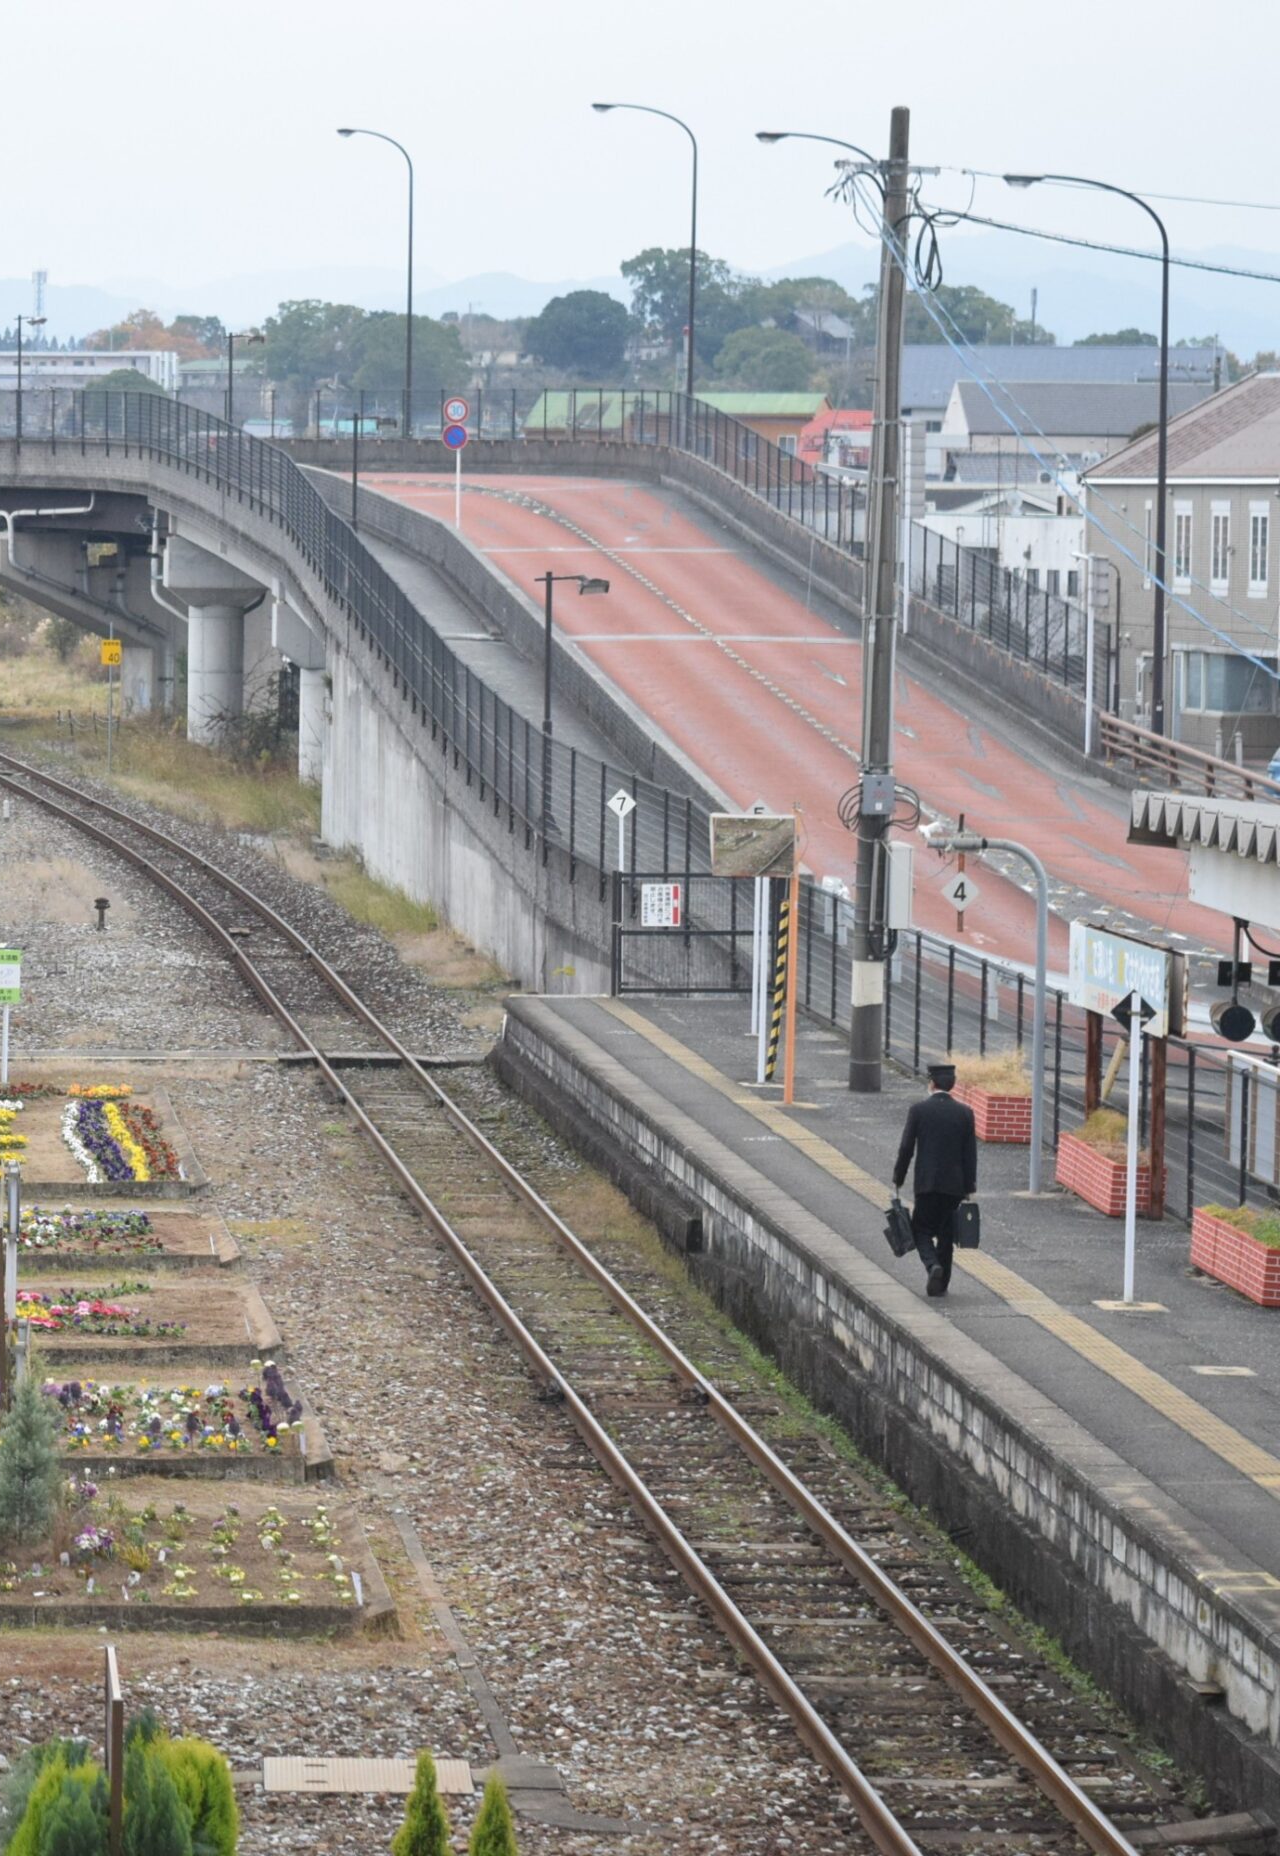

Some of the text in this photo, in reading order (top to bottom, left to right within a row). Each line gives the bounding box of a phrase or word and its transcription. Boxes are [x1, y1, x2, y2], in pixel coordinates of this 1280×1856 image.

[449, 404, 464, 417] 30
[108, 652, 120, 663] 40
[616, 796, 626, 811] 7
[953, 881, 966, 901] 4
